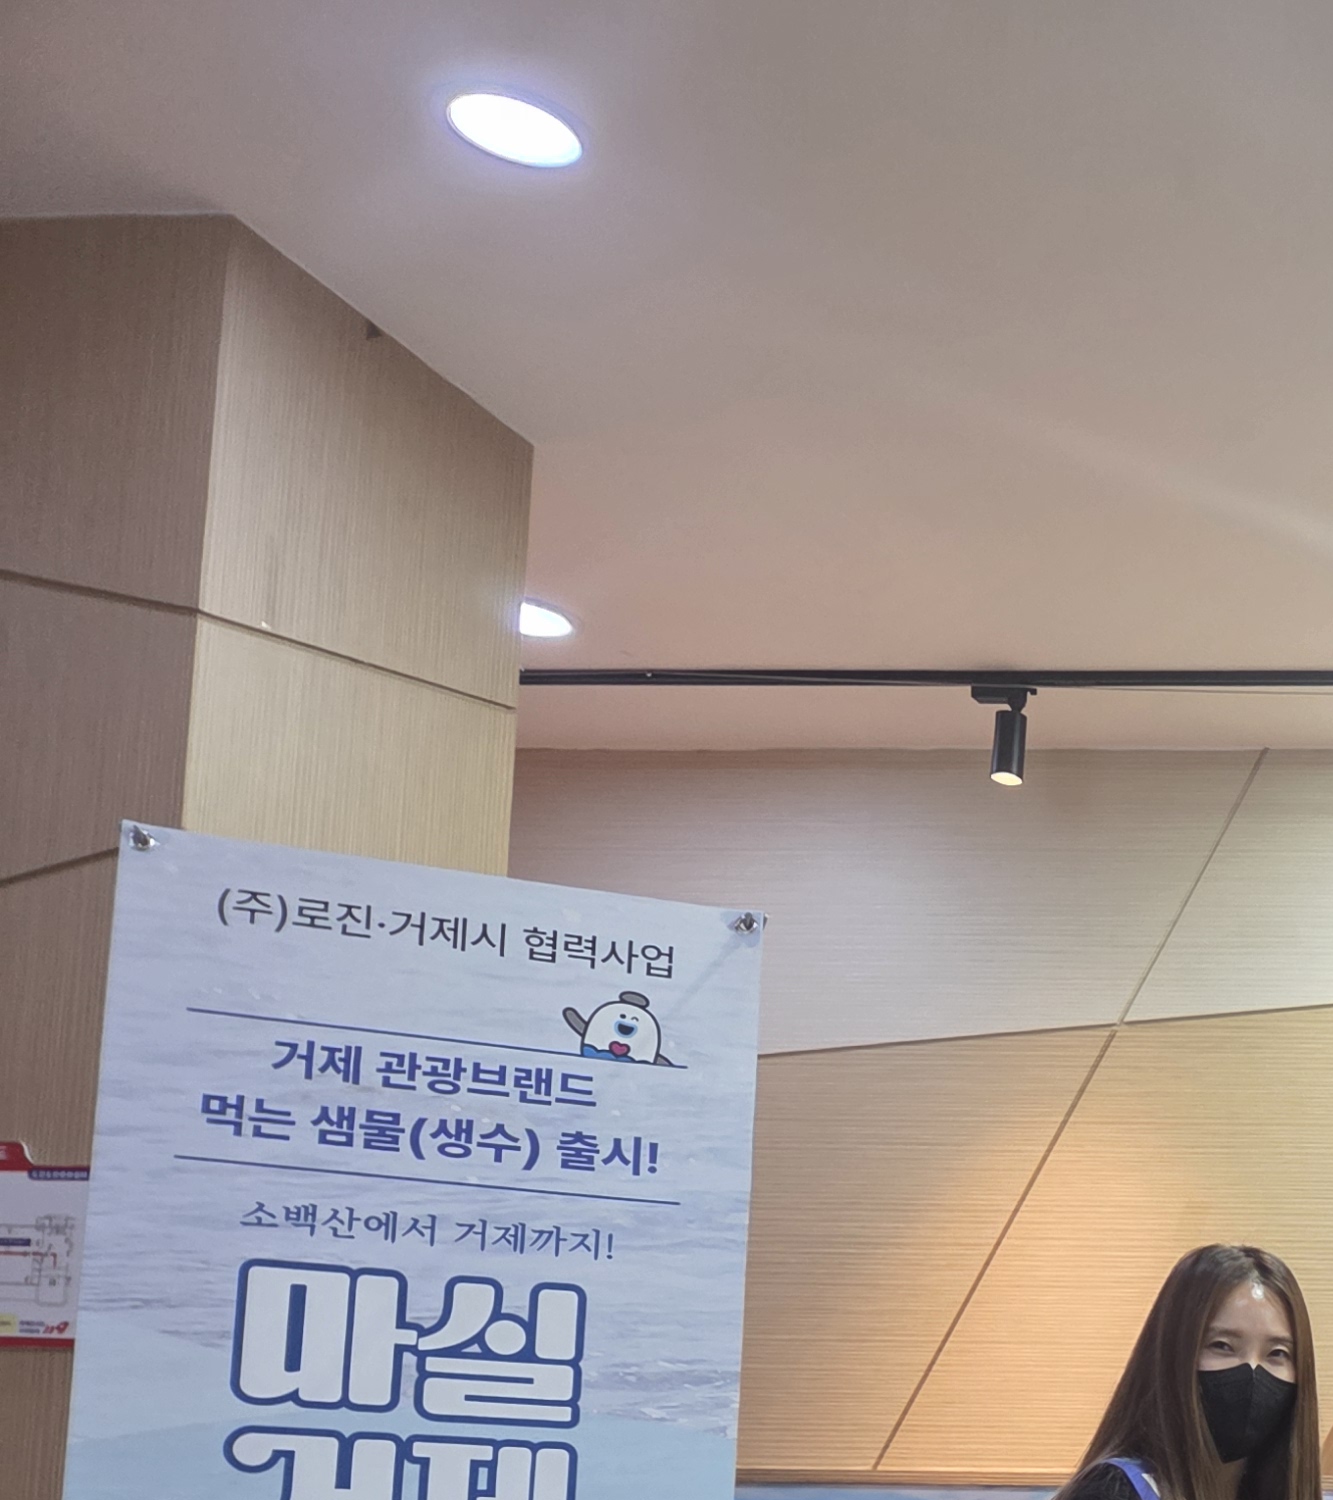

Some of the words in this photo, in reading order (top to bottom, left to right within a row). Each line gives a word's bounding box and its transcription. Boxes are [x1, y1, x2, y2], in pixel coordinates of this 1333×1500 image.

[523, 925, 674, 978] 협력사업
[271, 1040, 362, 1085] 거제
[376, 1050, 597, 1107] 관광브랜드
[200, 1093, 296, 1142] 먹는
[310, 1103, 540, 1171] 샘물(생수)
[556, 1130, 660, 1177] 출시!
[239, 1201, 438, 1248] 소백산에서
[454, 1218, 615, 1261] 거제까지!
[230, 1258, 587, 1428] 마실
